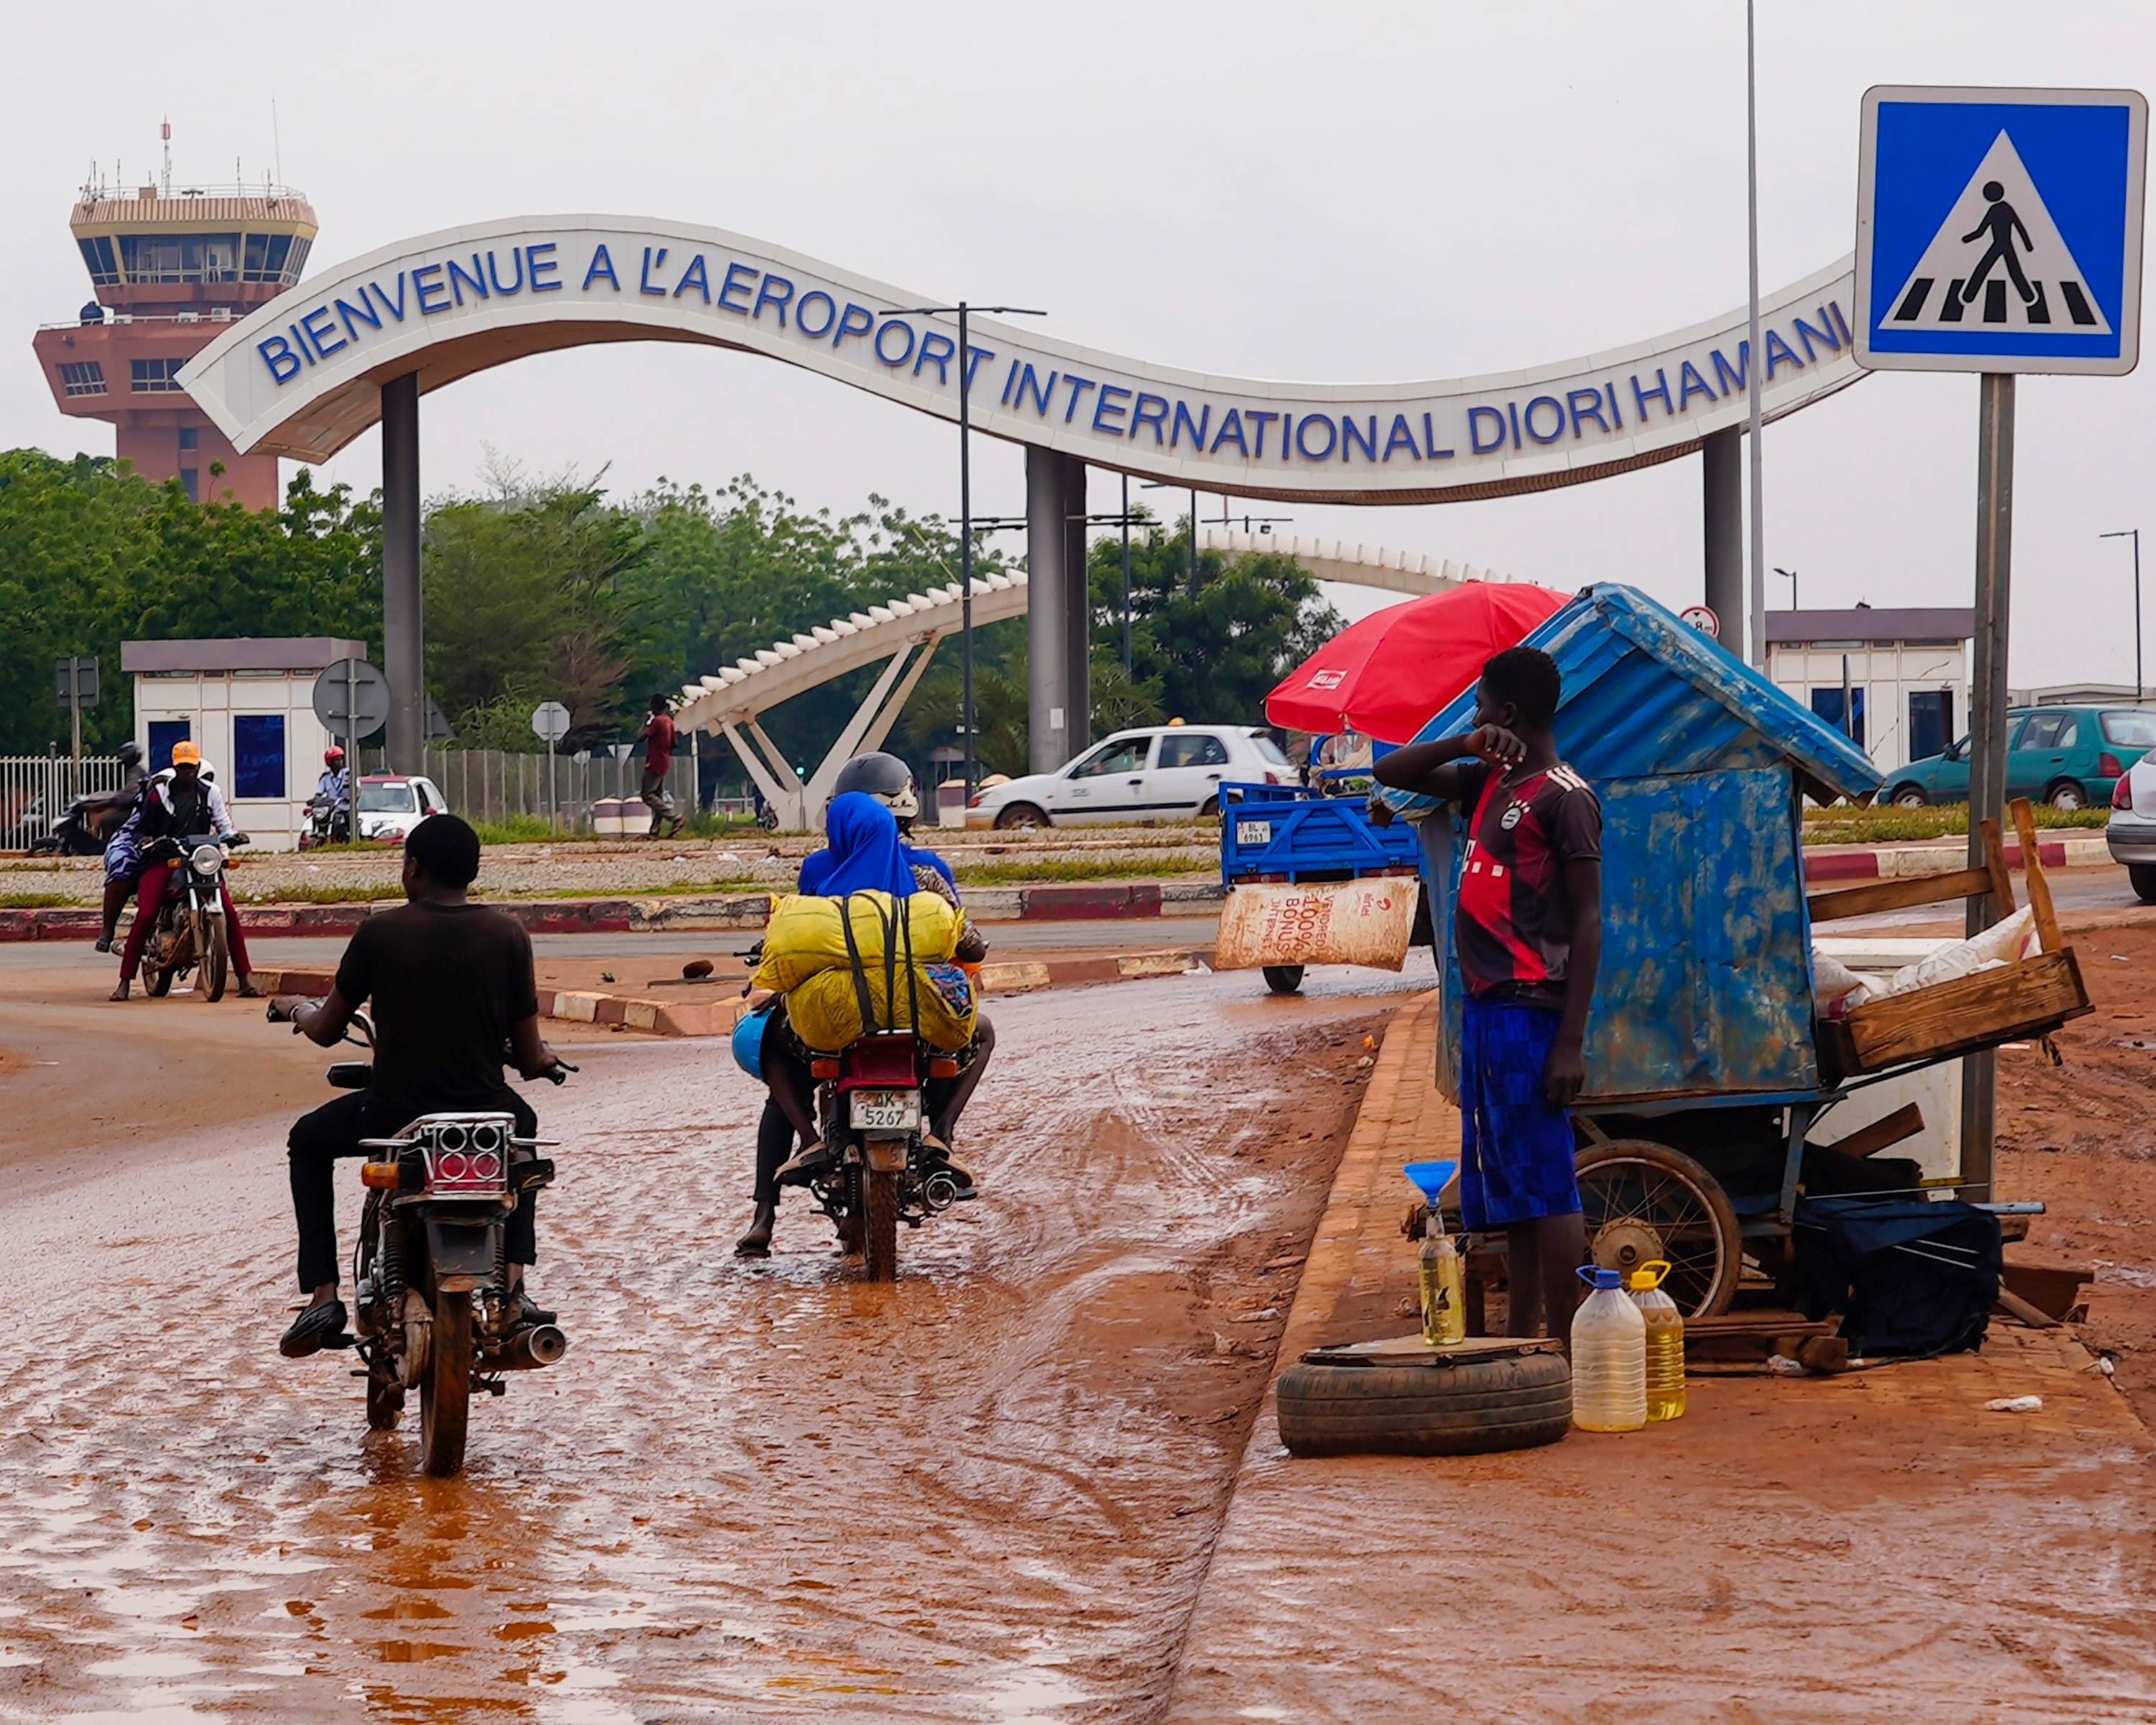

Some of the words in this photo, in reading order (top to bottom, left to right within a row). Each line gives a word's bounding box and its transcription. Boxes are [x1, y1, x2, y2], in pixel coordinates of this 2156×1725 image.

[257, 242, 563, 385] BIENVENUE
[582, 244, 621, 291] A
[640, 247, 996, 392] L'AEROPORT
[1002, 359, 1455, 462] INTERNATIONAL
[1468, 382, 1623, 454] DIORI
[1631, 300, 1853, 421] HAMANI
[1276, 898, 1300, 952] BONUS
[1293, 894, 1319, 952] 100%
[866, 1109, 904, 1126] 5267
